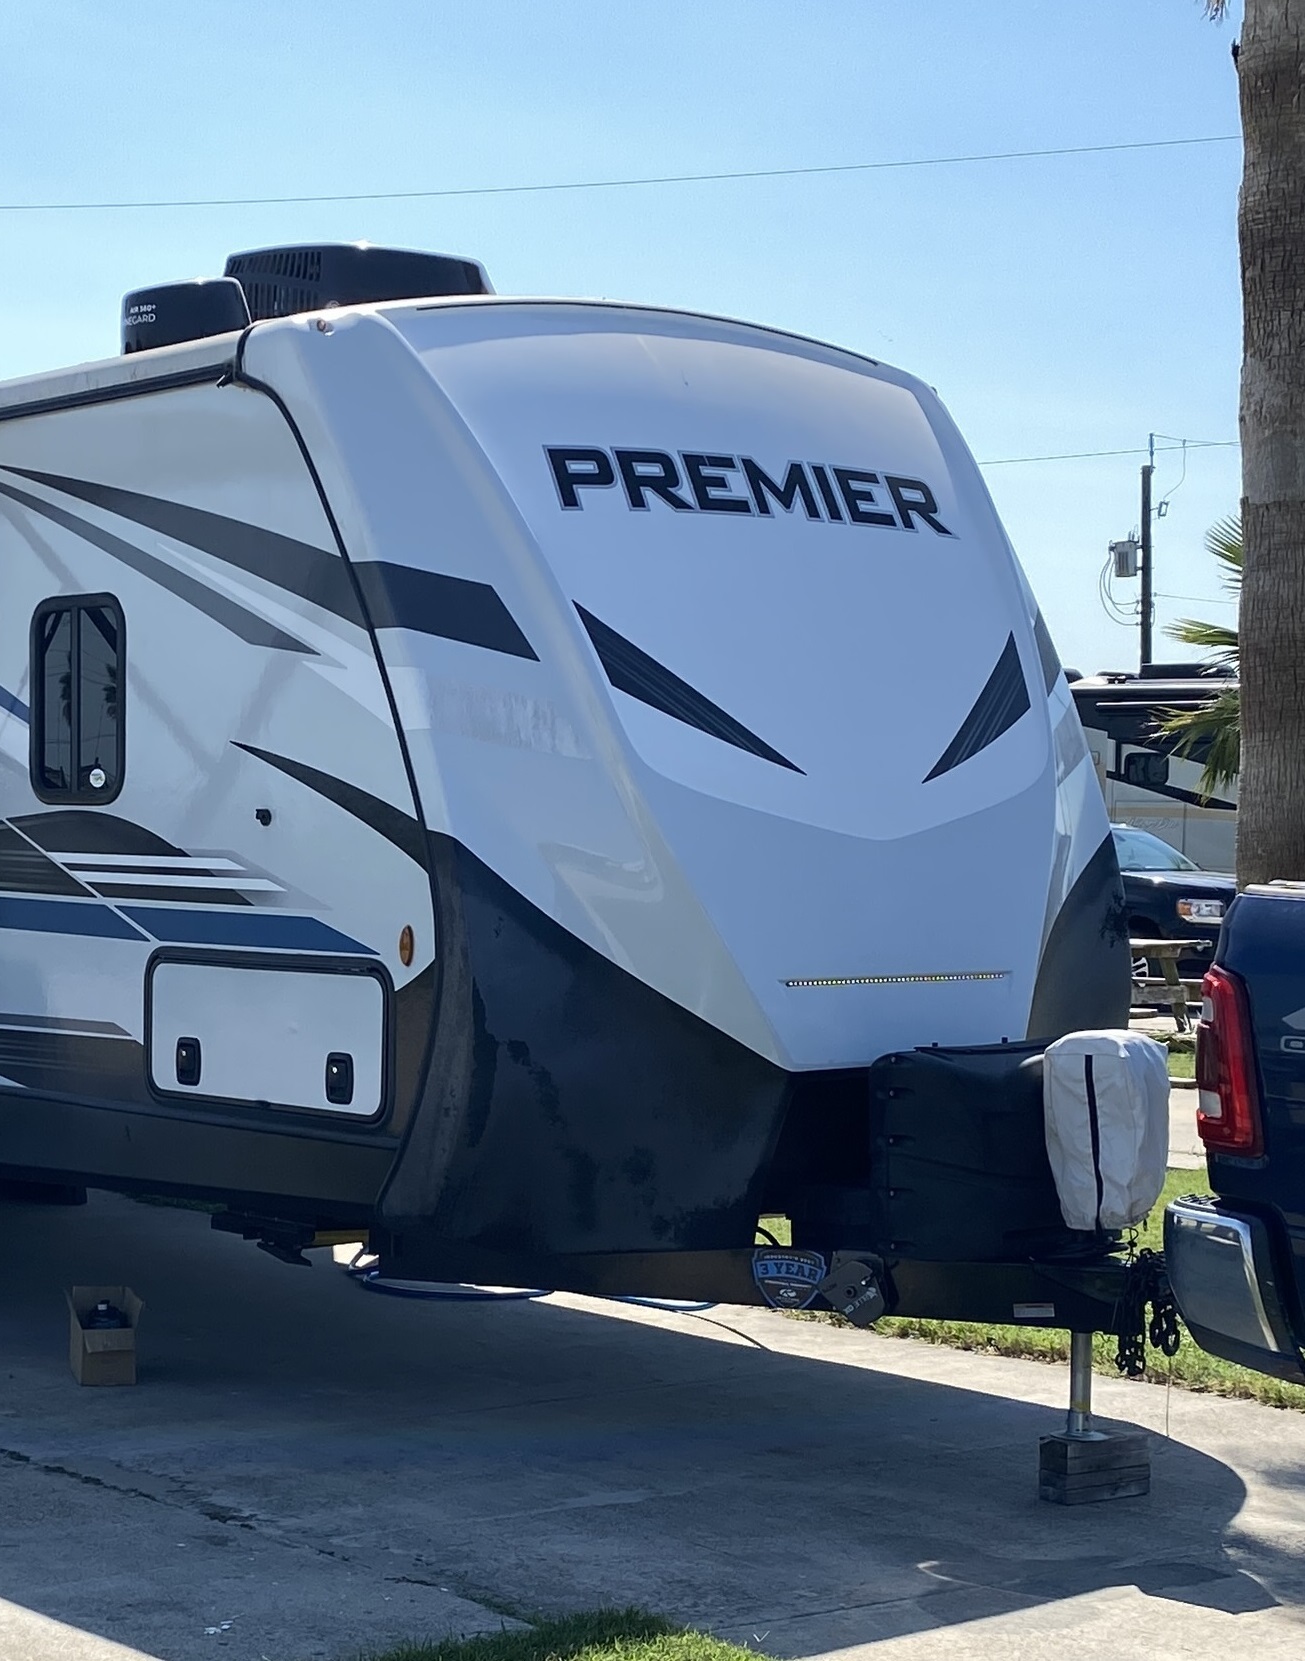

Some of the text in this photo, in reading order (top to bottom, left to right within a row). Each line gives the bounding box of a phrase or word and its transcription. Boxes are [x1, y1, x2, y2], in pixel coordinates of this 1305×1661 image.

[542, 444, 960, 540] PREMIER
[759, 1262, 818, 1281] 3 YEAR
